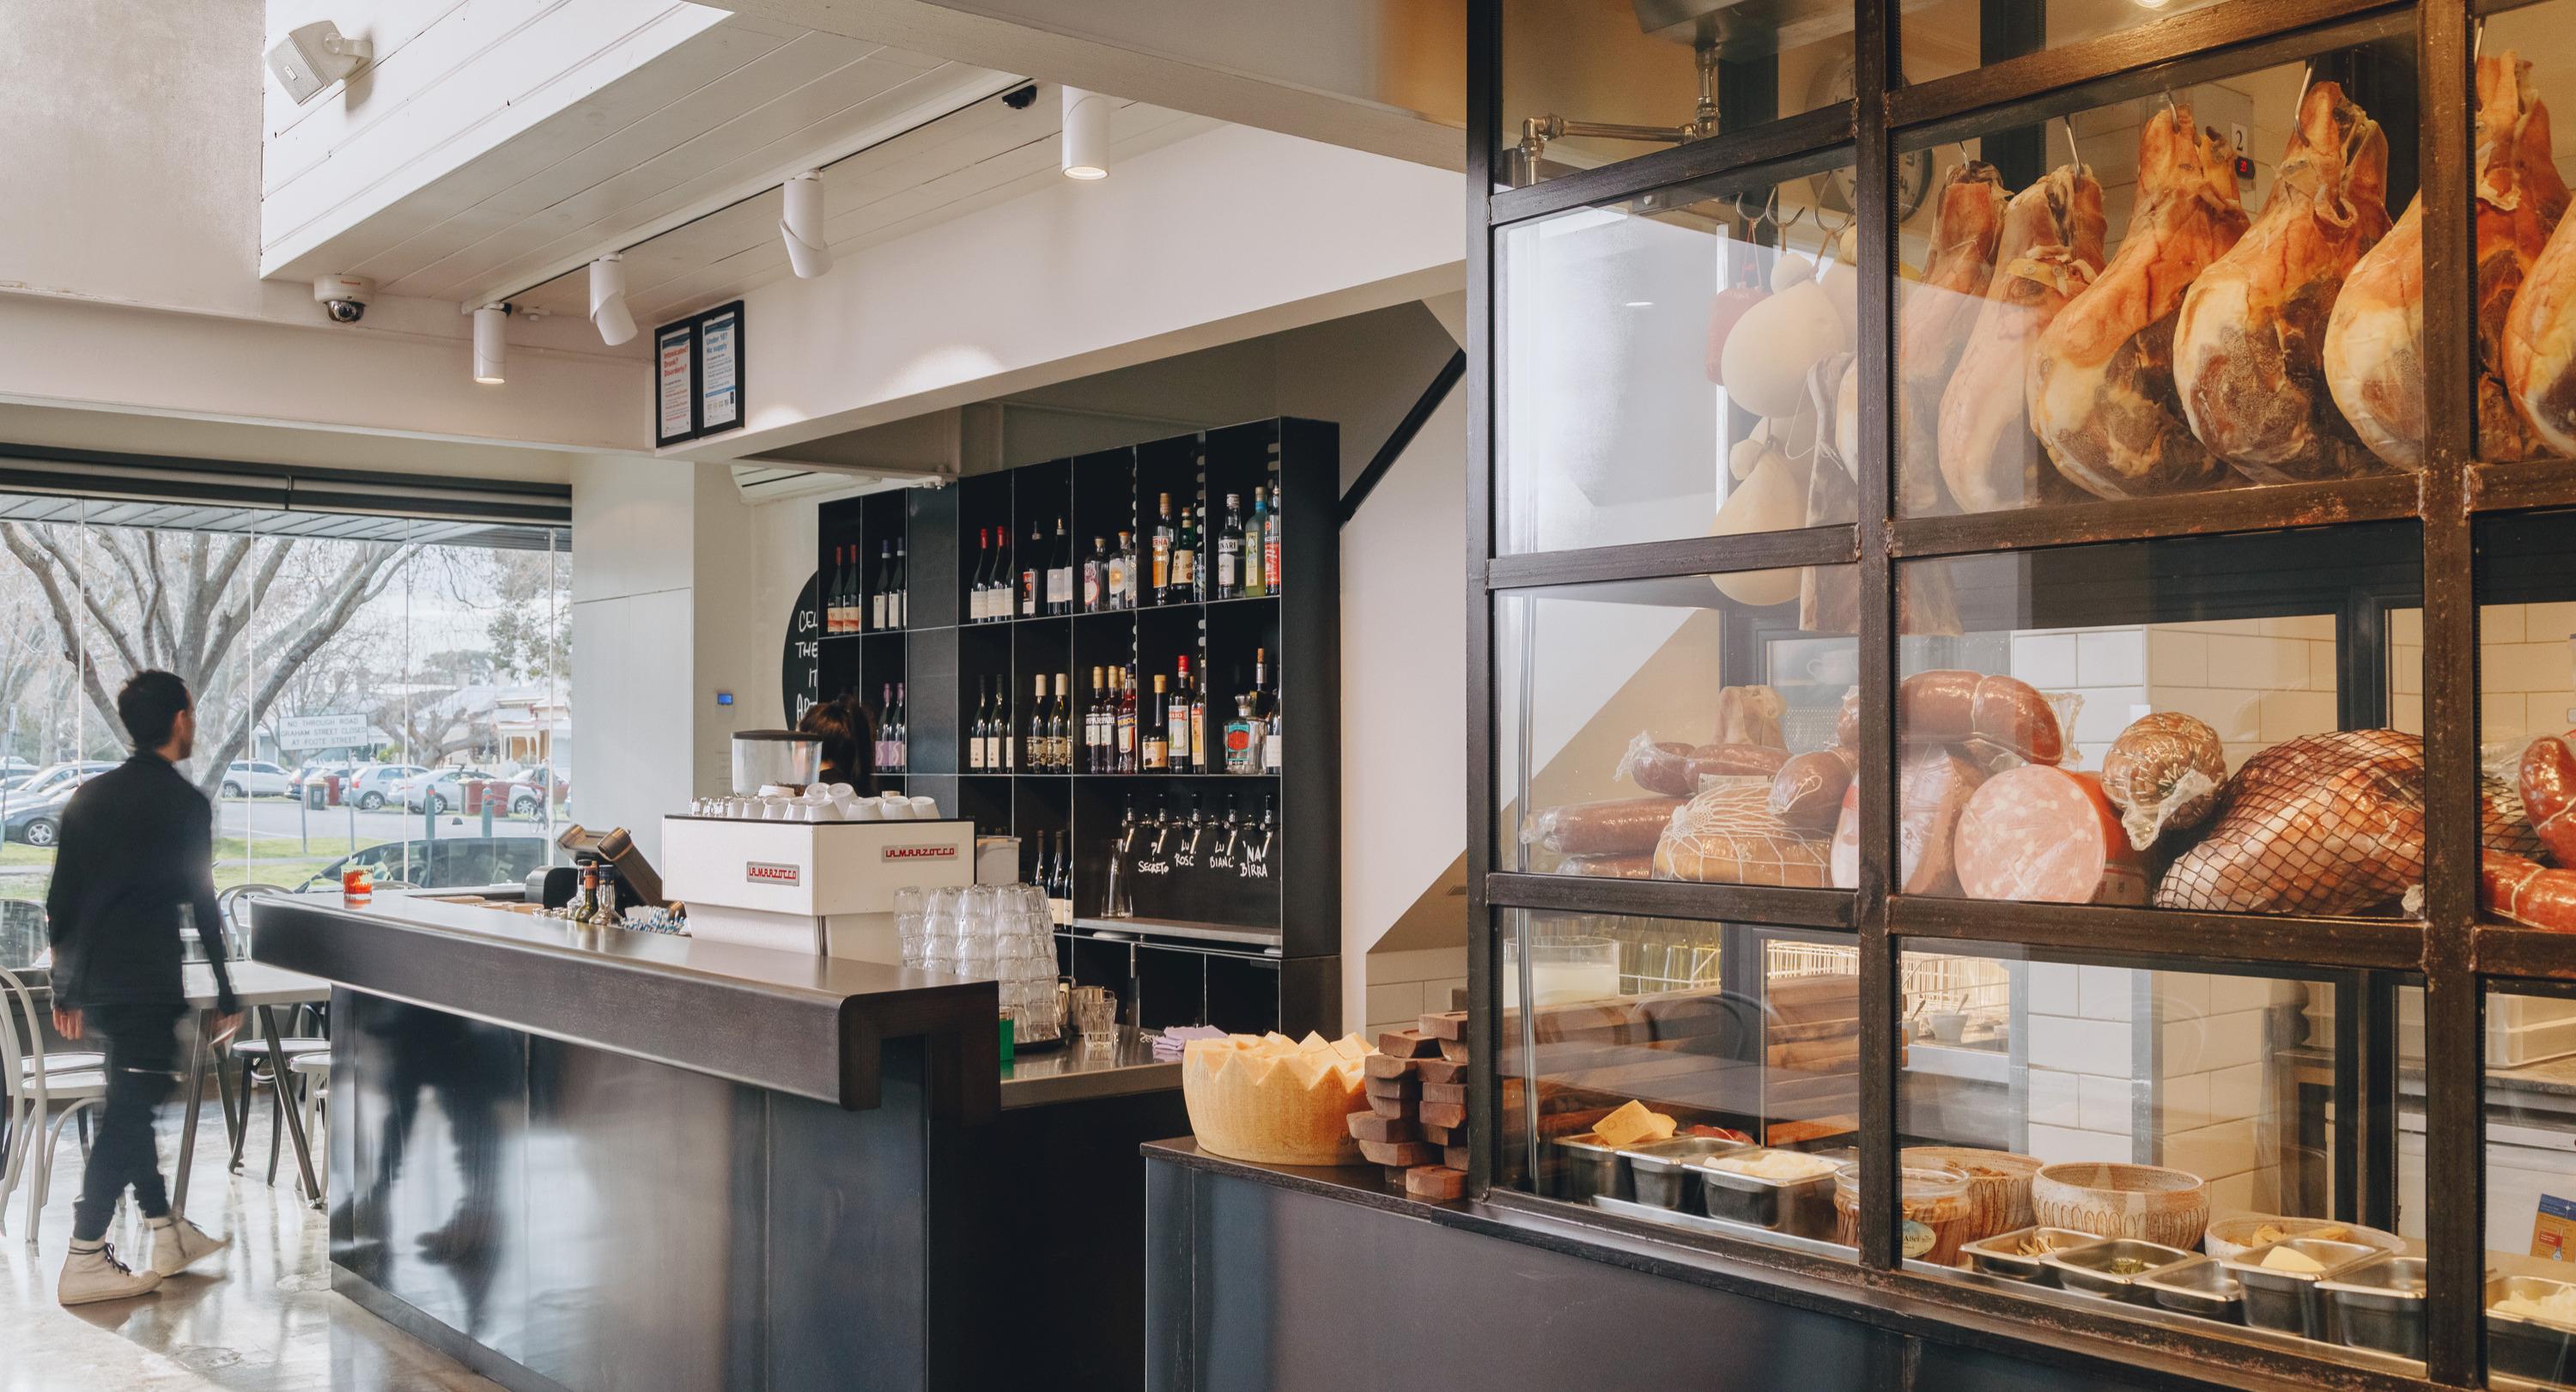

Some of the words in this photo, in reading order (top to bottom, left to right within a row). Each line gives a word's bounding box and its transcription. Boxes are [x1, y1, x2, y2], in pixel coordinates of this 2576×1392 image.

[2235, 130, 2244, 152] 2
[1215, 841, 1224, 853] LU
[1240, 862, 1268, 878] BIRRA
